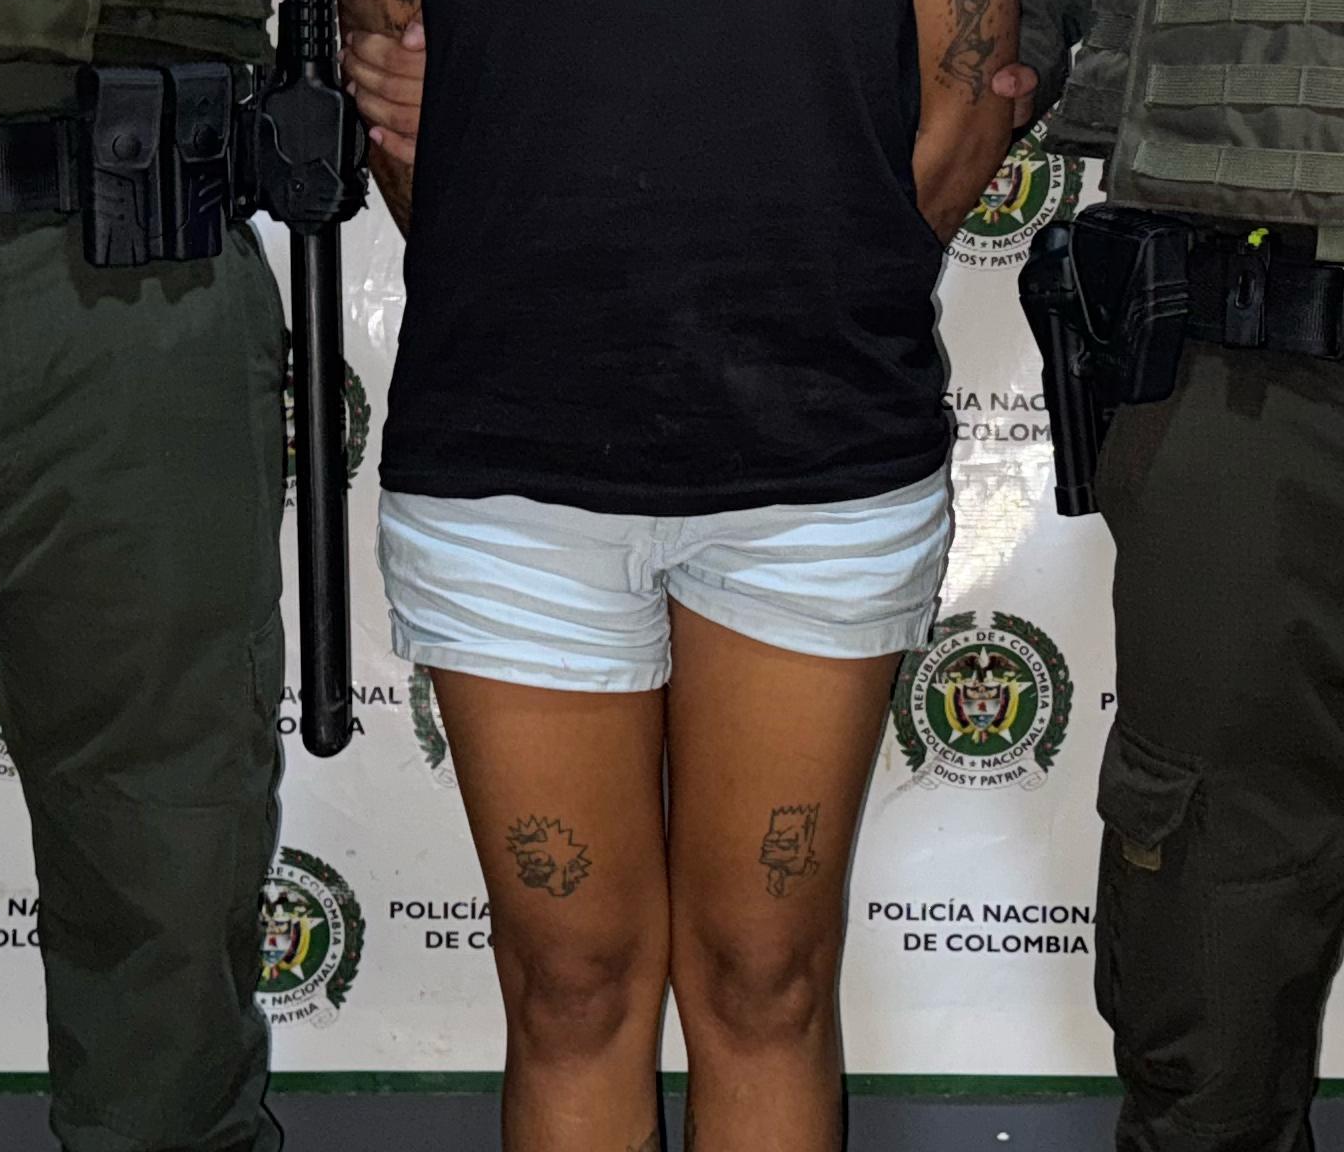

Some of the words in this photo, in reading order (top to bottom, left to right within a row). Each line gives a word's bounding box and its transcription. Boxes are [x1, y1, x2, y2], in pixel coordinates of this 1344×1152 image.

[991, 204, 1054, 248] NACIONAL
[953, 422, 1052, 442] COLOM
[976, 632, 996, 642] DE
[1007, 638, 1050, 710] COLOMBIA
[981, 724, 1044, 768] NACIONAL
[980, 766, 1027, 786] PATRIA
[265, 866, 286, 877] DE
[297, 874, 342, 946] COLOMBIA
[389, 894, 492, 920] POLICÍA
[868, 898, 975, 922] POLICÍA
[983, 905, 1092, 925] NACION
[425, 930, 459, 949] DE
[903, 932, 937, 952] DE
[945, 933, 1089, 955] COLOMBIA
[273, 960, 336, 1005] NACIONAL
[272, 1003, 320, 1023] PATRIA
